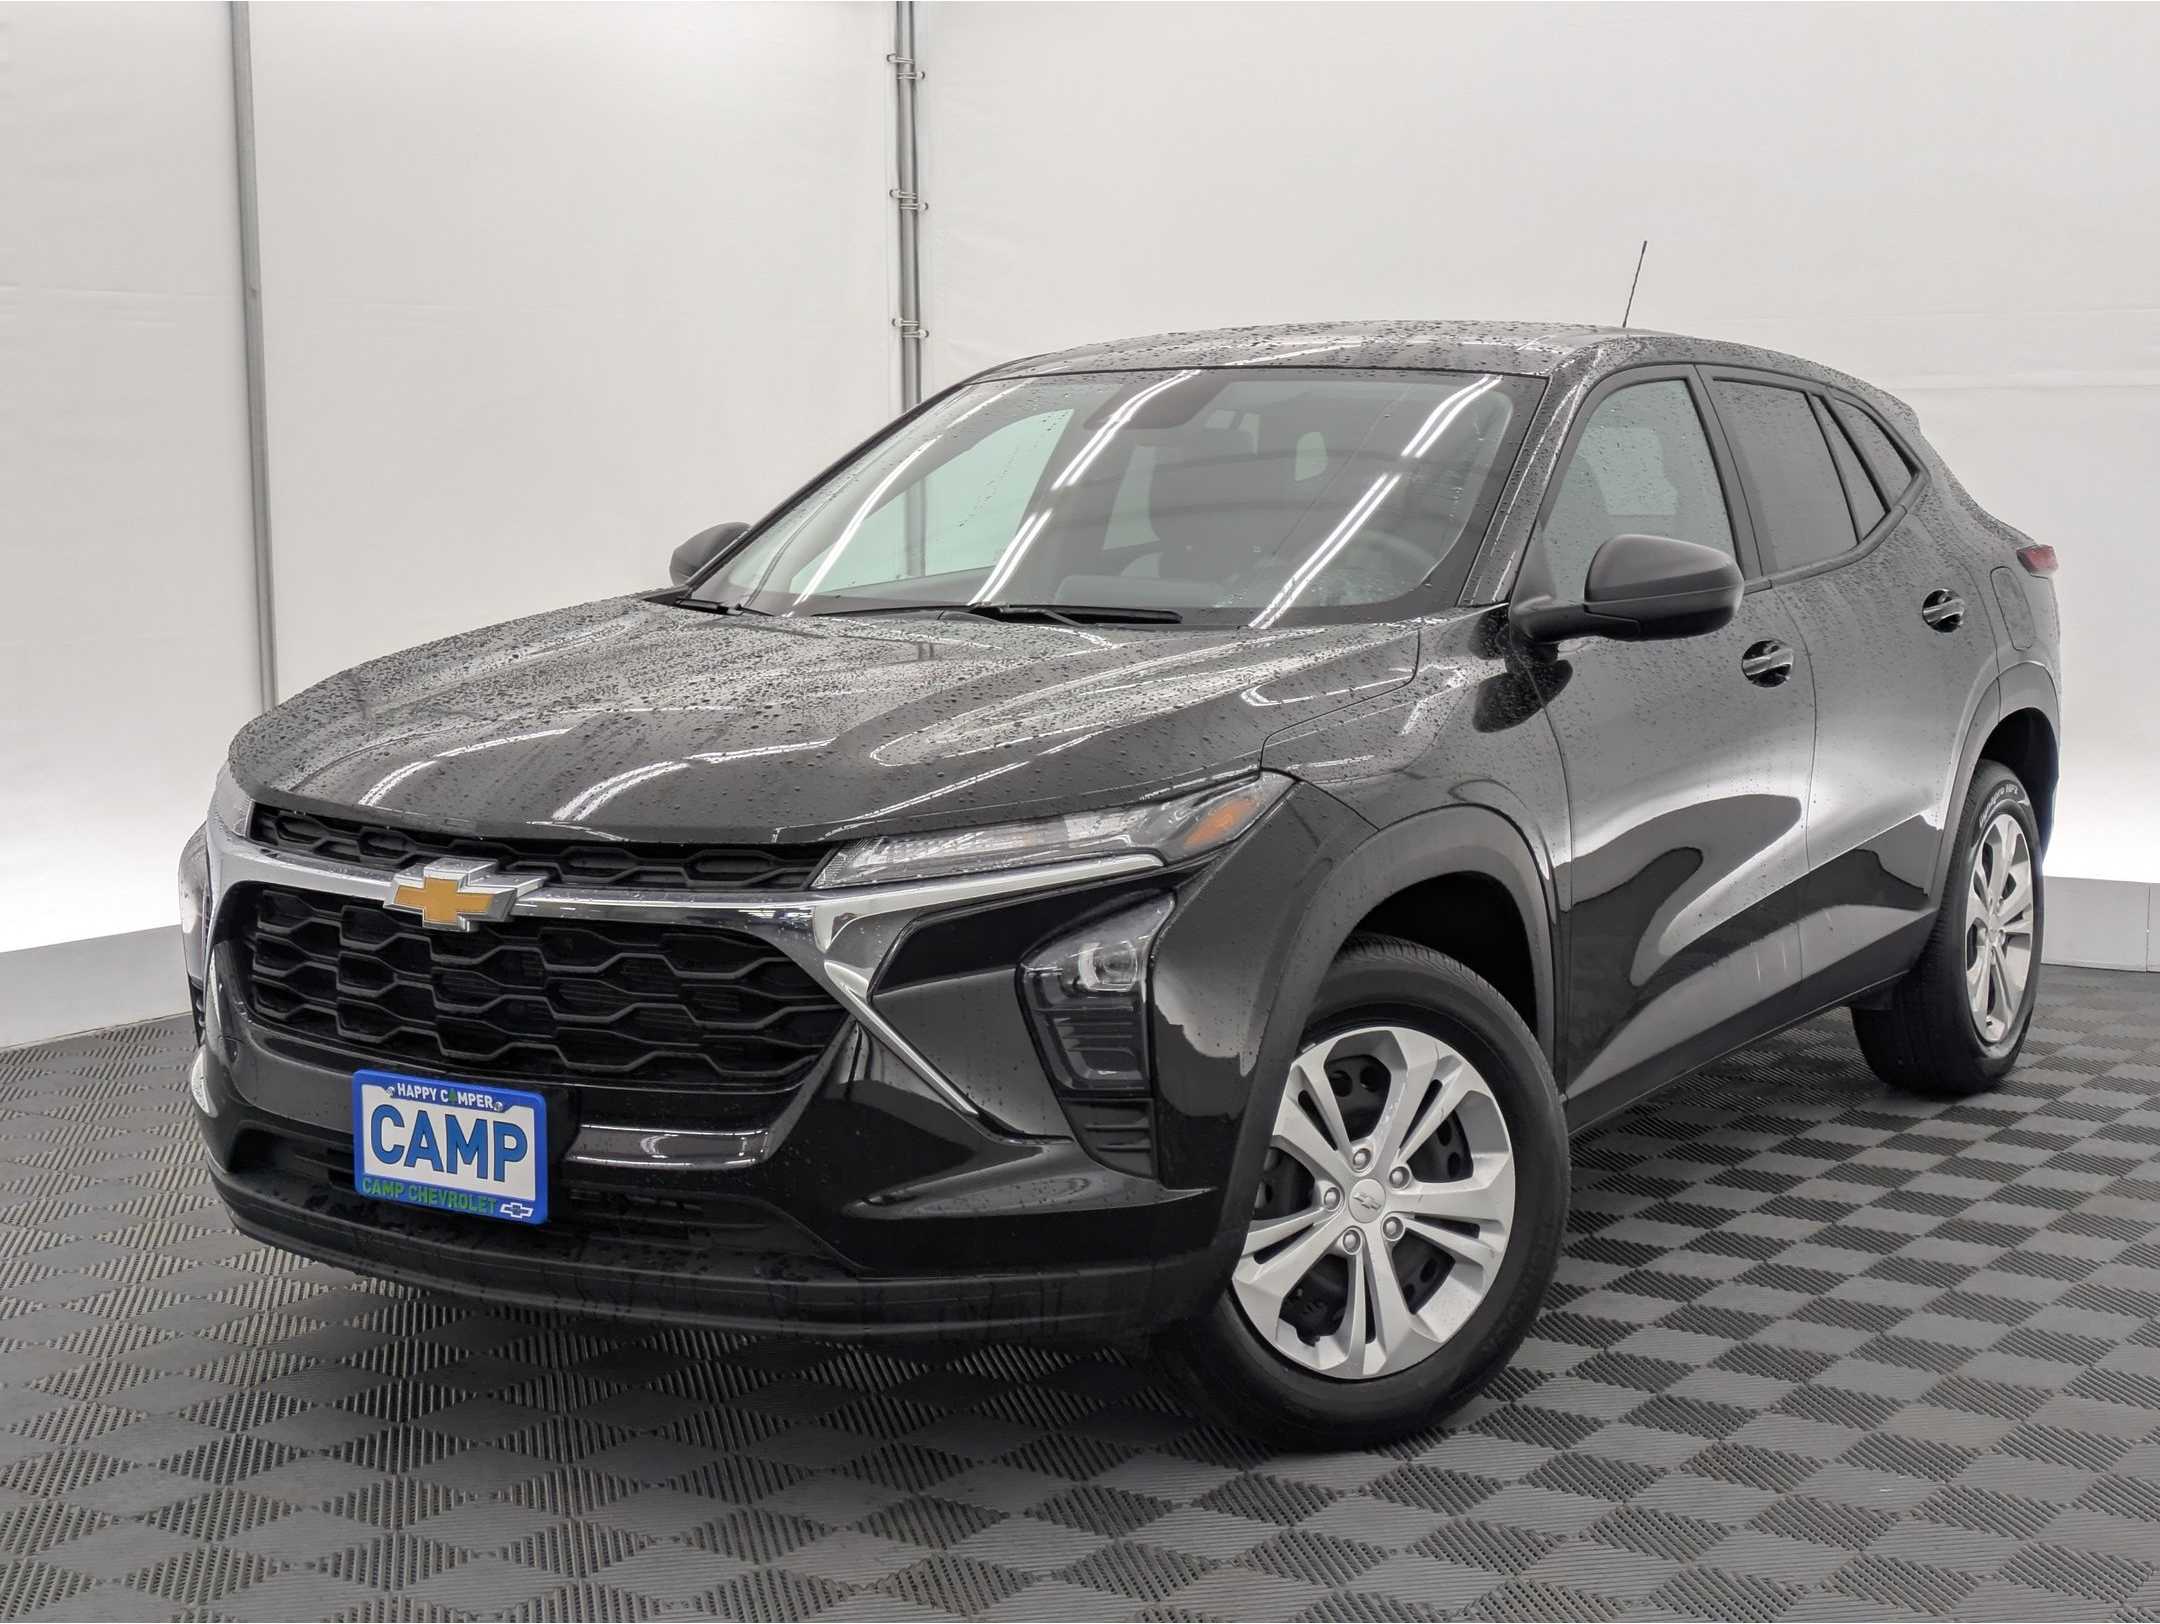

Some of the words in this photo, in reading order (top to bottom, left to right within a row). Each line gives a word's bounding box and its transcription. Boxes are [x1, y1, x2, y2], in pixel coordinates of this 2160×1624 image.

[397, 1083, 437, 1101] HAPPY
[371, 1104, 528, 1182] CAMP
[362, 1177, 404, 1199] CAMP
[408, 1184, 497, 1215] CHEVROLET
